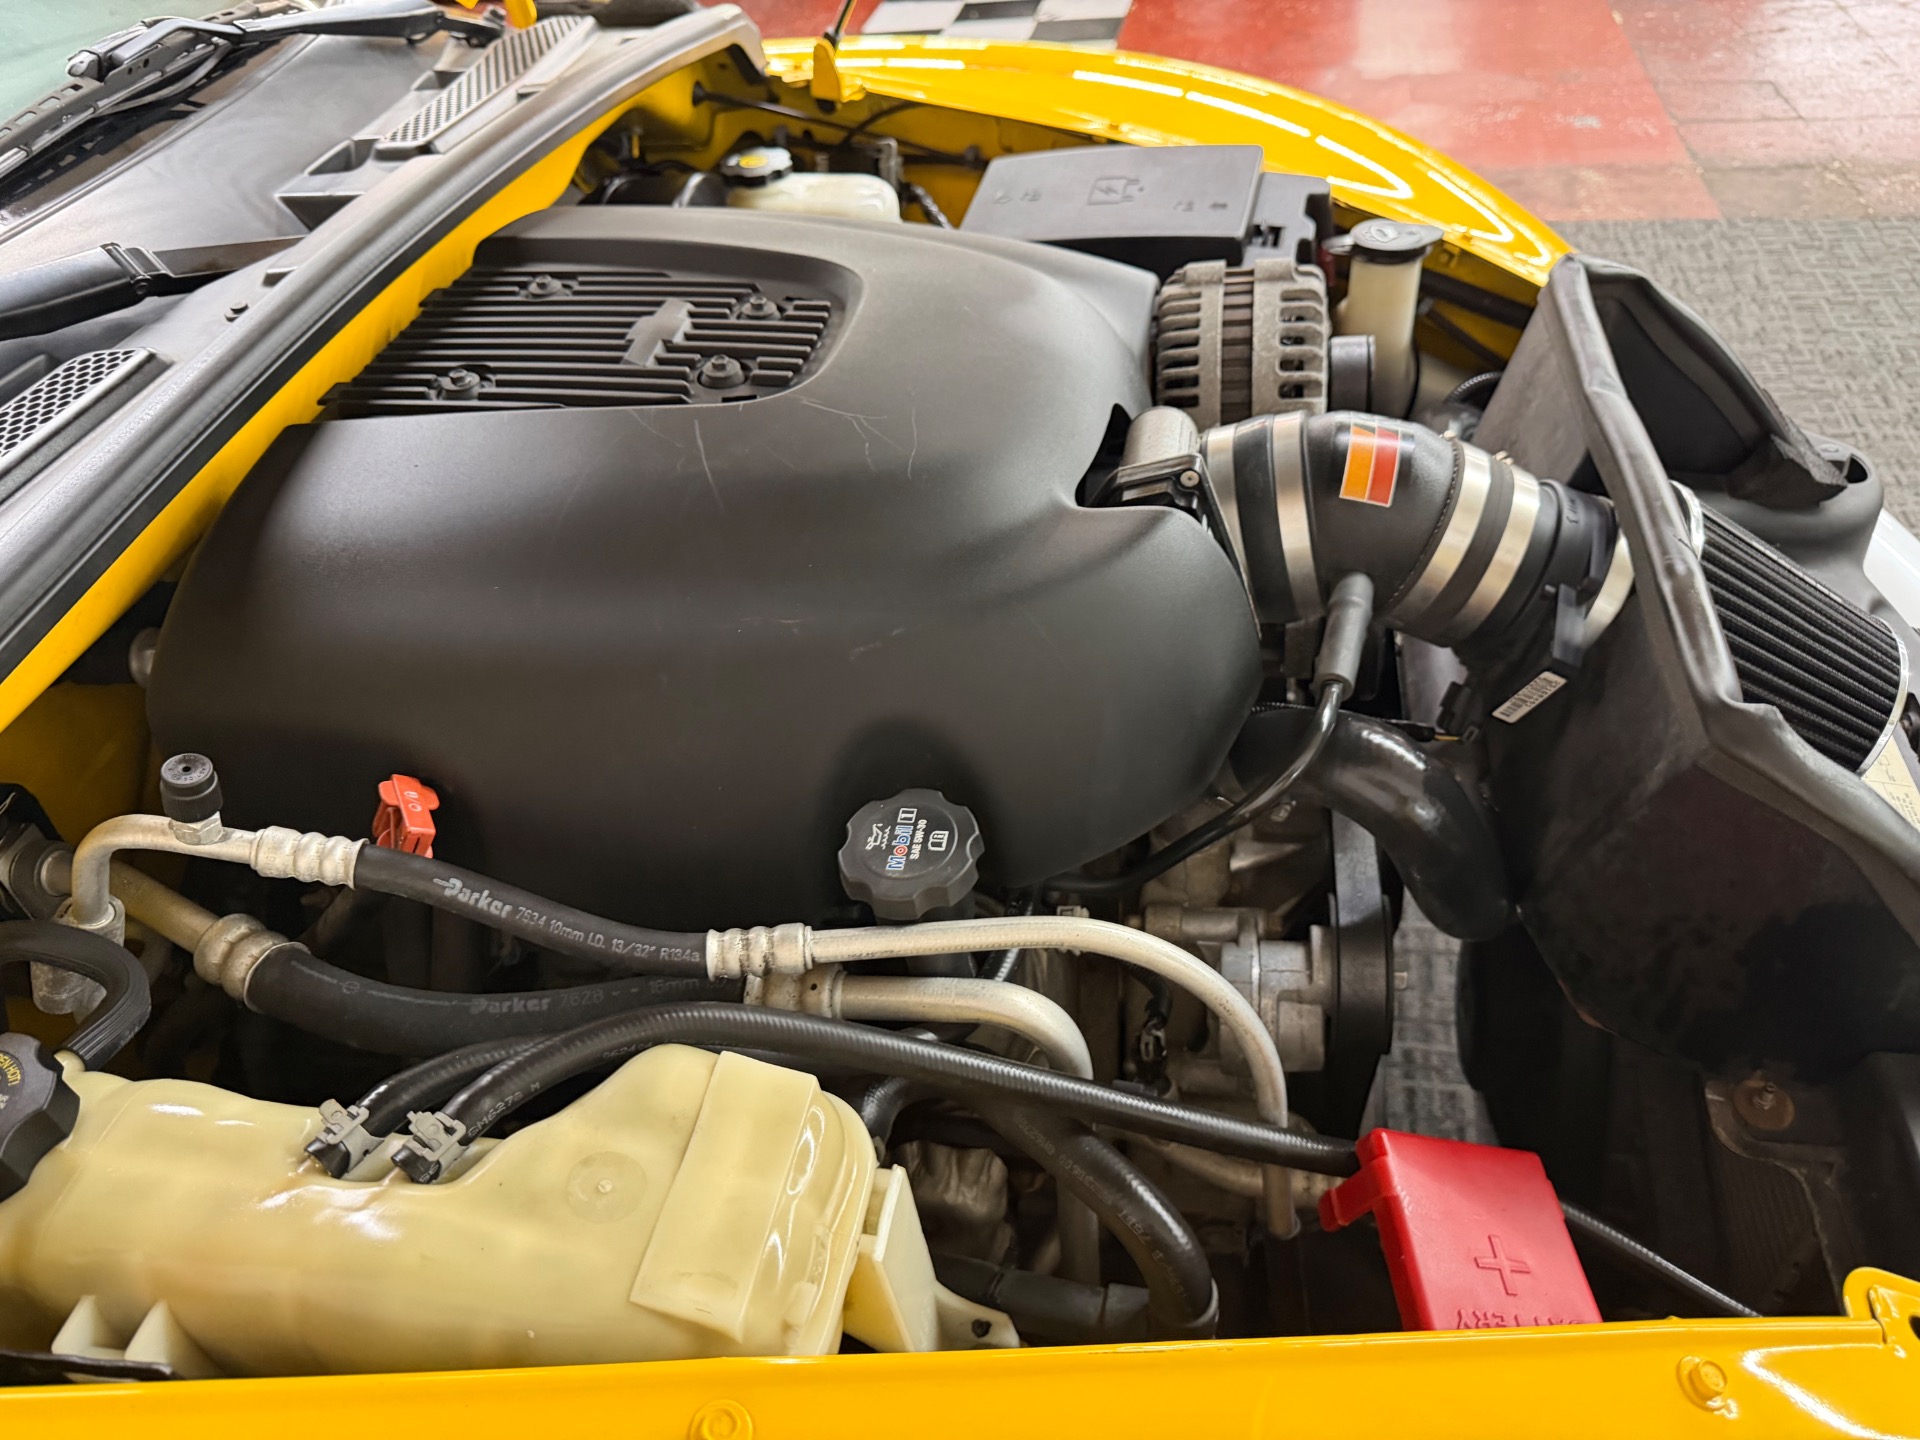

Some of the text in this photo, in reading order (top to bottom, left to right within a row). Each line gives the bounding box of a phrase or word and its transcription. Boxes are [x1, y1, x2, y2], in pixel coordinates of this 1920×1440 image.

[886, 825, 913, 870] Mobil
[910, 819, 927, 860] SAE 5W-30
[436, 877, 513, 918] Parker
[549, 919, 584, 942] 10mm
[660, 947, 700, 962] R134a
[468, 996, 552, 1015] Parker
